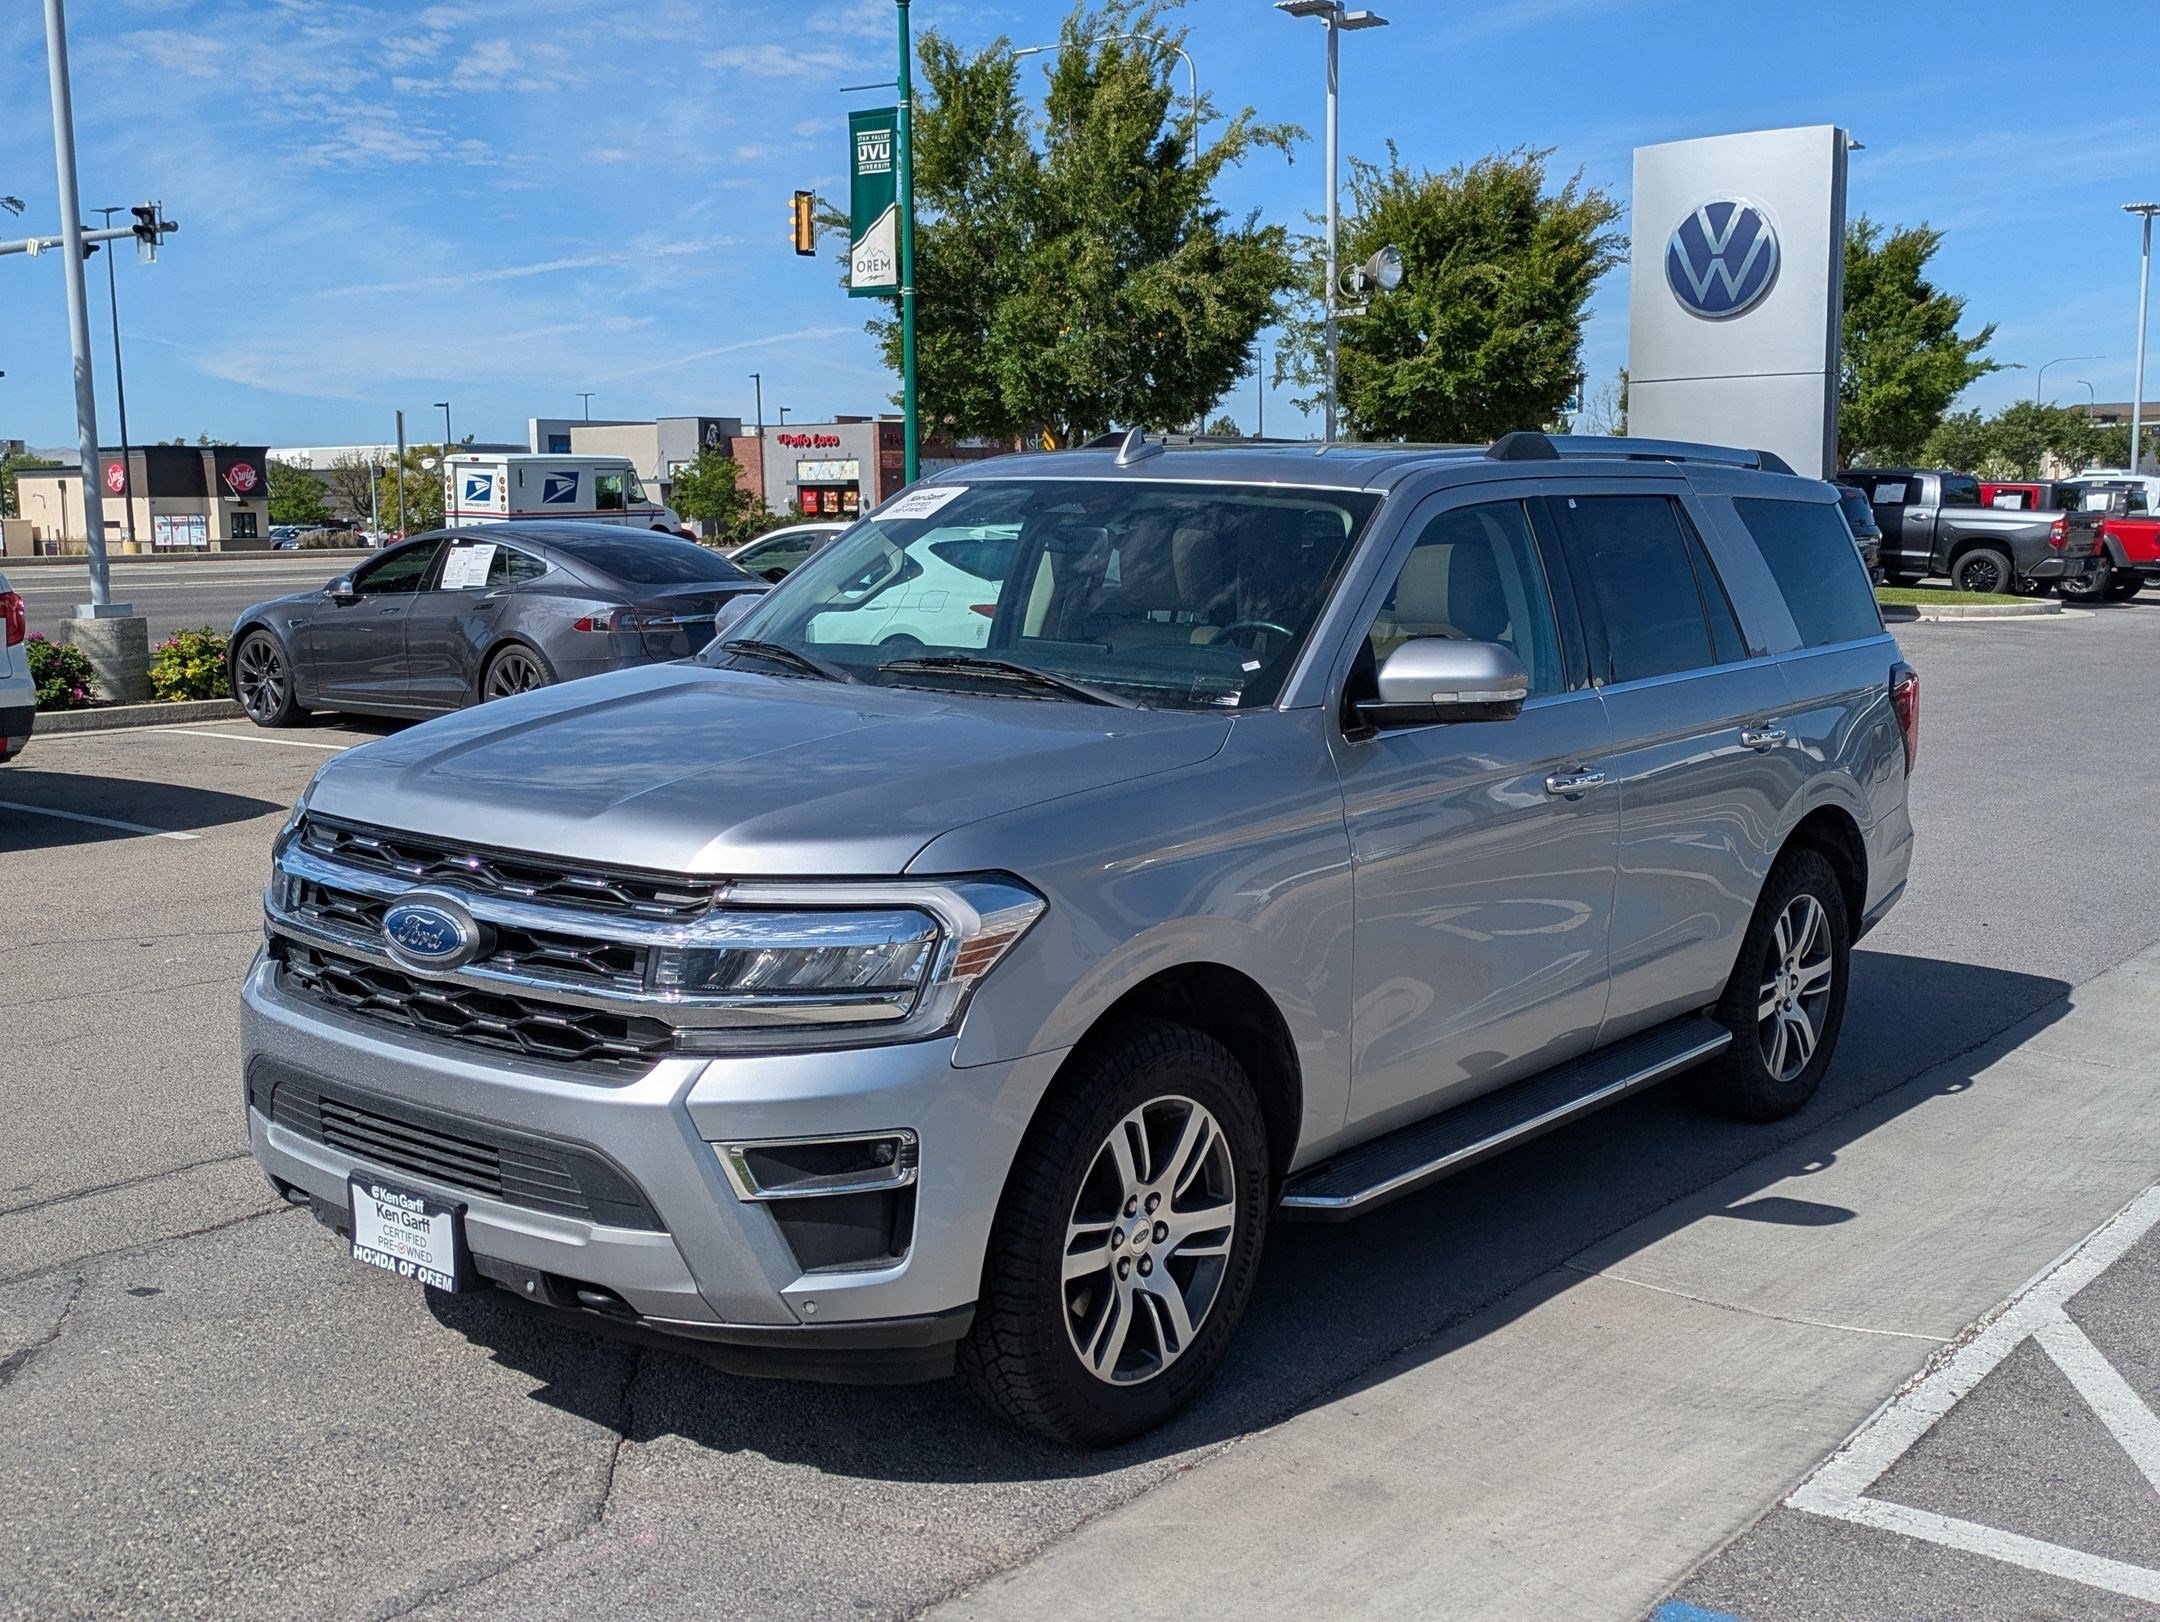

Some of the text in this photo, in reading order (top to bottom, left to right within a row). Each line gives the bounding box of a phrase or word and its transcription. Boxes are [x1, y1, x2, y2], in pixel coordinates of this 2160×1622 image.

[857, 143, 890, 161] UVU
[856, 258, 891, 273] OREM
[784, 433, 811, 448] Pollo
[813, 433, 840, 448] Loco
[228, 466, 258, 488] Swig
[396, 914, 445, 950] Ford
[379, 1188, 424, 1213] Ken Garff
[376, 1202, 431, 1234] Ken Garff
[382, 1224, 427, 1248] CERTIFIED
[353, 1245, 452, 1293] HONDA OF OREM
